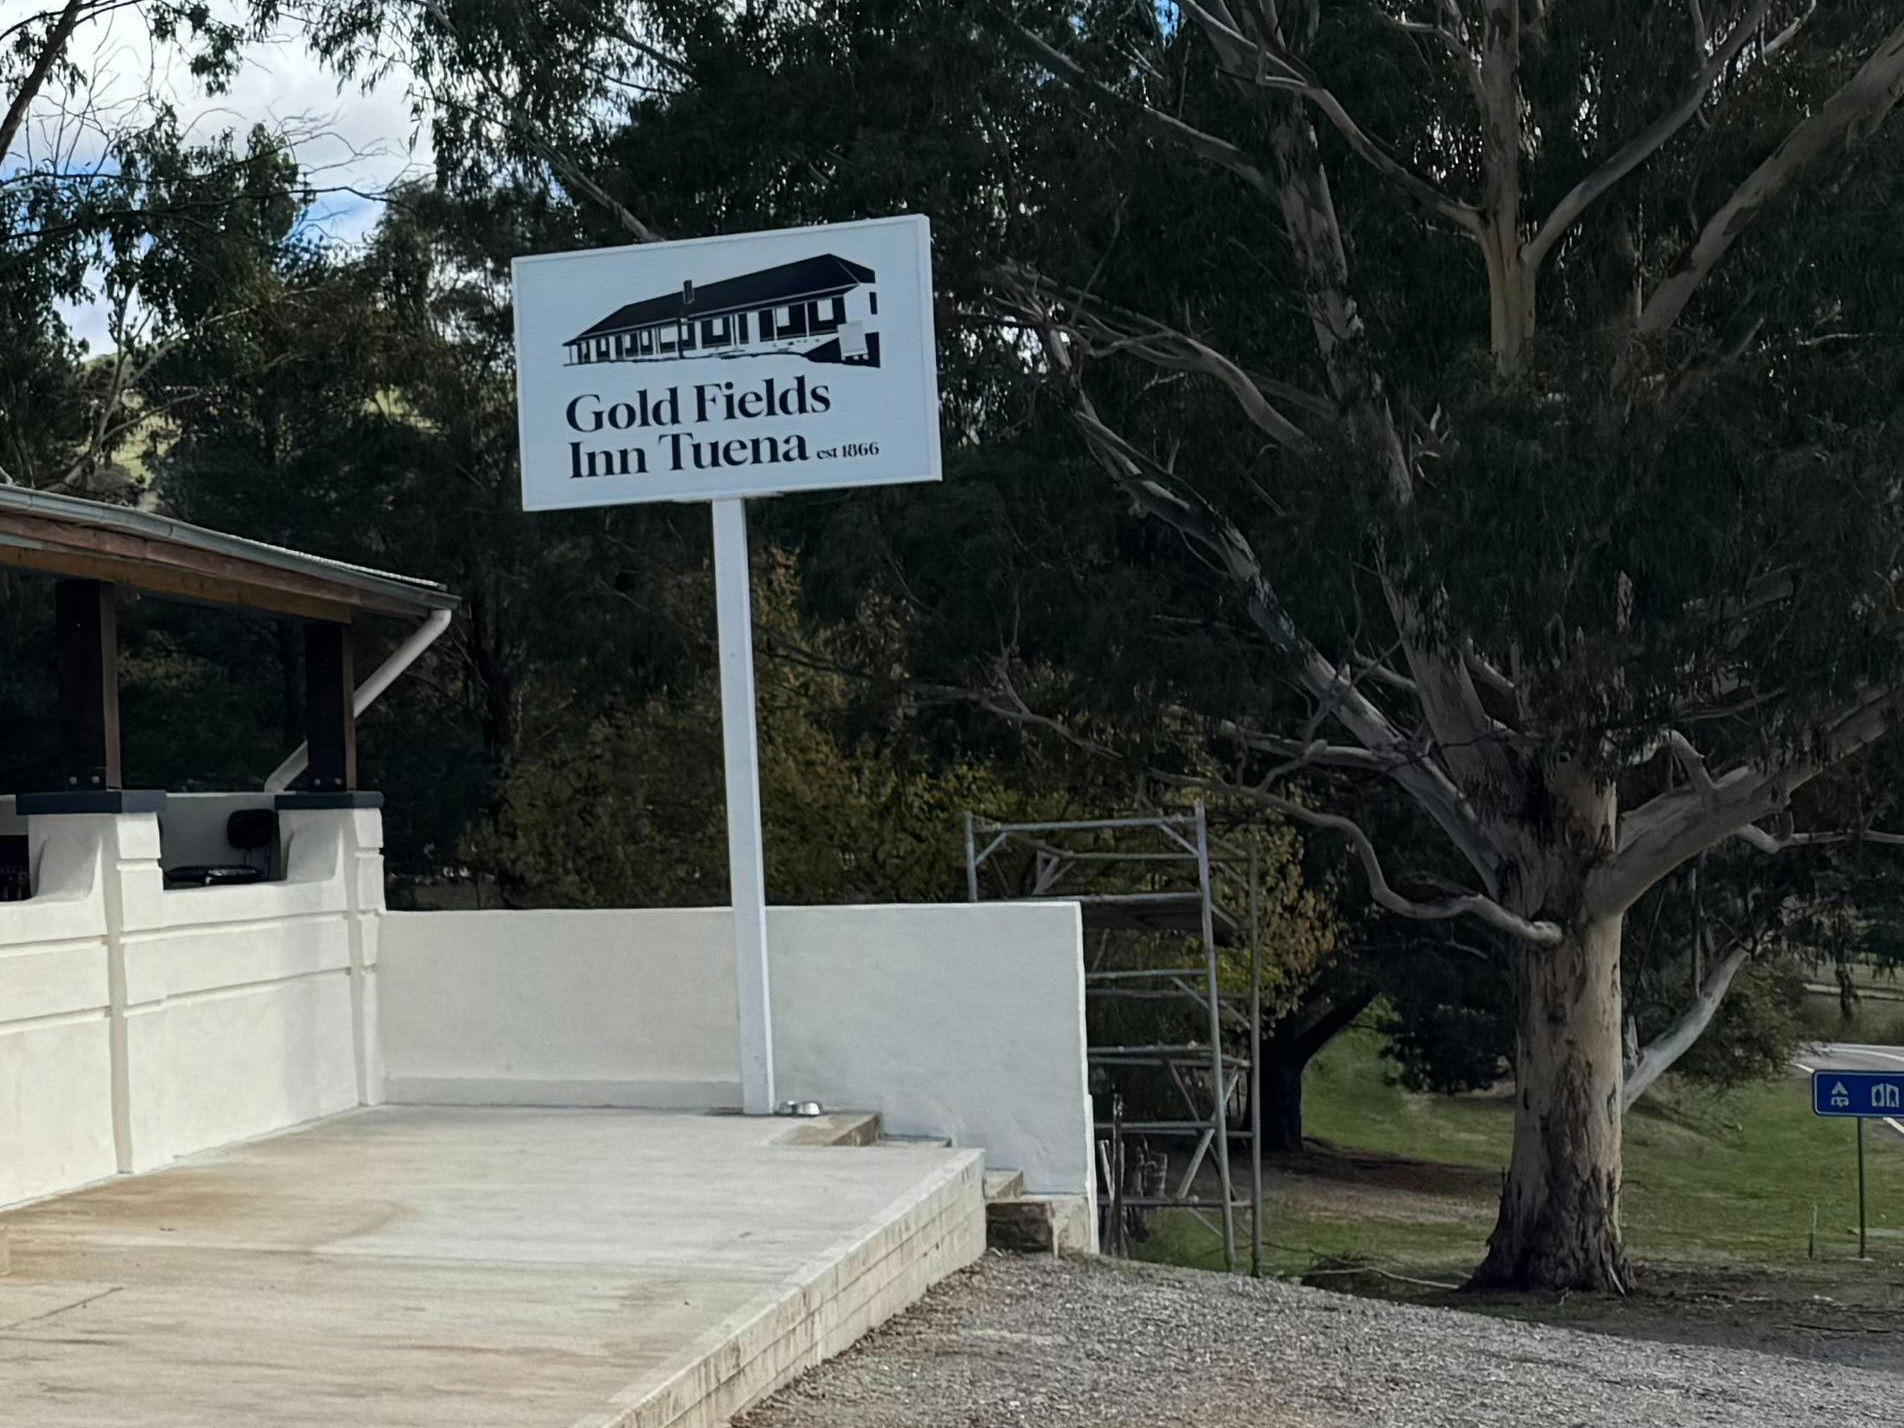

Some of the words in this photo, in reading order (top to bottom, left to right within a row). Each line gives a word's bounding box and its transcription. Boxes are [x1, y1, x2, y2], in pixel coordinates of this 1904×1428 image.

[565, 386, 681, 433] Gold
[694, 375, 832, 423] Fields
[568, 441, 650, 479] Inn
[658, 432, 810, 472] Tuena
[816, 447, 839, 460] est
[841, 442, 880, 459] 1866
